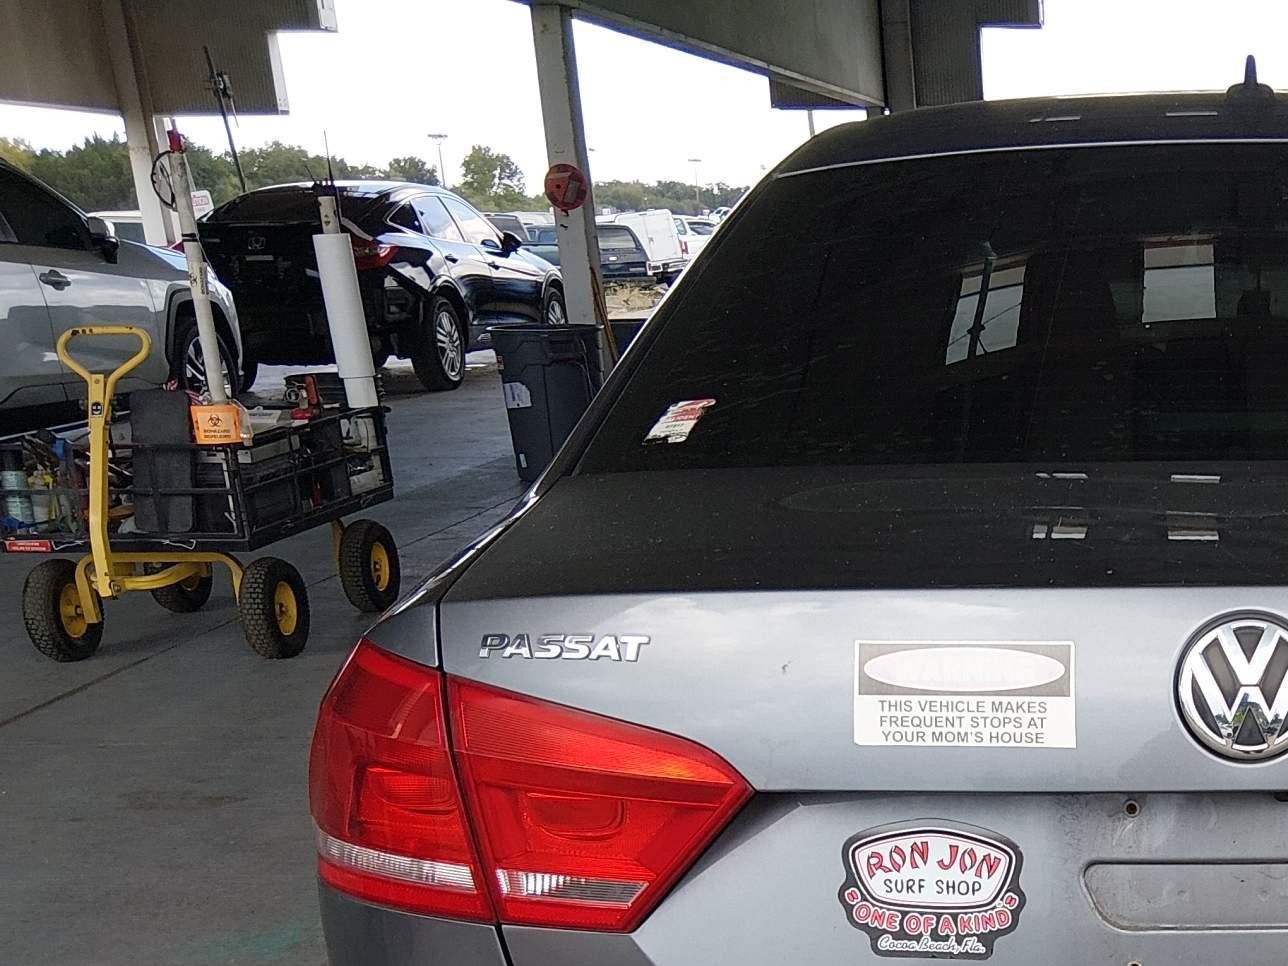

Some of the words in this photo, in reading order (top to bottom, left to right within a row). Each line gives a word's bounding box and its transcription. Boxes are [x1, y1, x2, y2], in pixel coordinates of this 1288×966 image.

[479, 633, 652, 662] PASSAT
[878, 700, 913, 713] THIS
[918, 700, 986, 713] VEHICLE
[991, 700, 1048, 714] MAKES
[879, 715, 965, 728] FREQUENT
[970, 716, 1023, 729] STOPS
[1027, 716, 1047, 729] AT
[881, 730, 926, 743] YOUR
[931, 730, 984, 744] MOM'S
[989, 731, 1045, 744] HOUSE
[866, 841, 929, 879] RON
[936, 844, 1001, 880] JON
[883, 878, 926, 894] SURF
[935, 879, 983, 896] SHOP
[904, 913, 935, 935] OF
[939, 915, 955, 935] A
